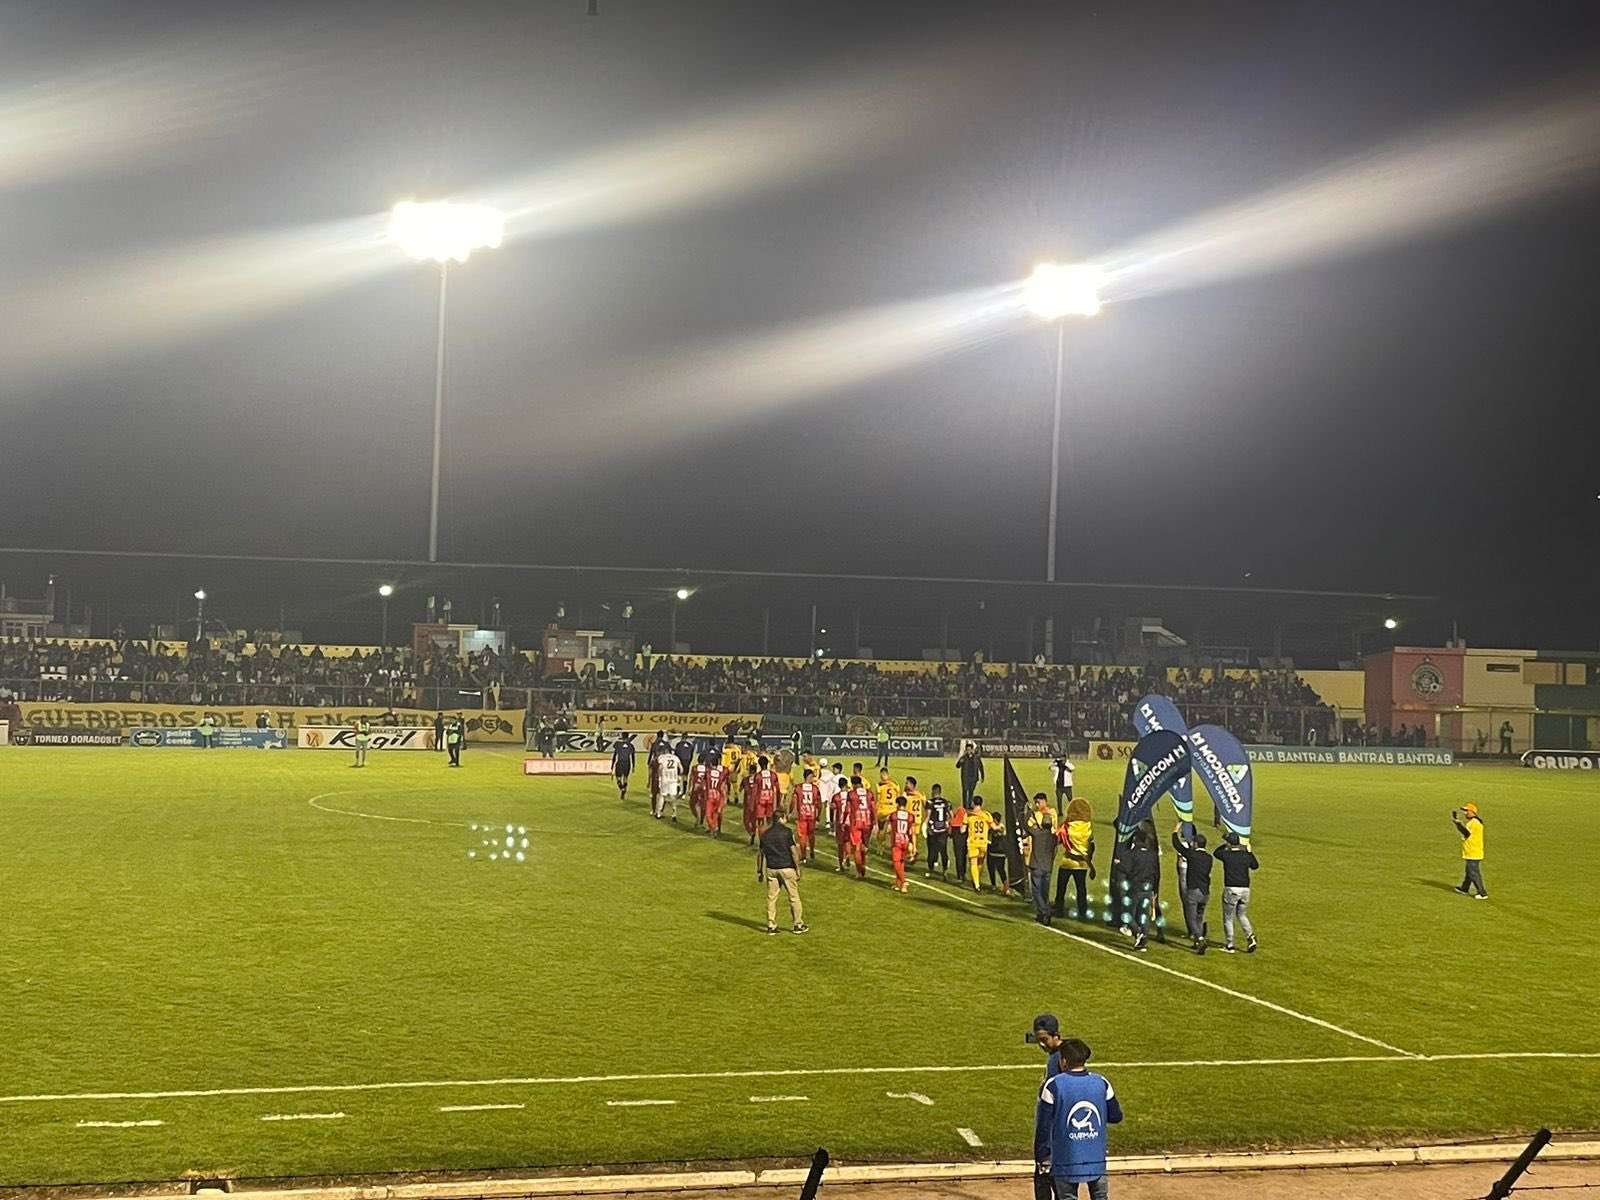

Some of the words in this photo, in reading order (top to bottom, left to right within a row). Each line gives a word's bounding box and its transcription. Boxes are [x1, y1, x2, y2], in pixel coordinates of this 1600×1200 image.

[35, 735, 68, 744] TORNEO
[329, 730, 416, 749] Rgil
[840, 739, 921, 750] ACREICOM
[1277, 751, 1334, 763] BANTRAB
[1338, 752, 1394, 764] BANTRAB
[1397, 753, 1452, 765] BANTRAB
[1534, 755, 1592, 769] GRUPO
[1127, 753, 1176, 809] ACREDICOM
[973, 821, 985, 834] 99
